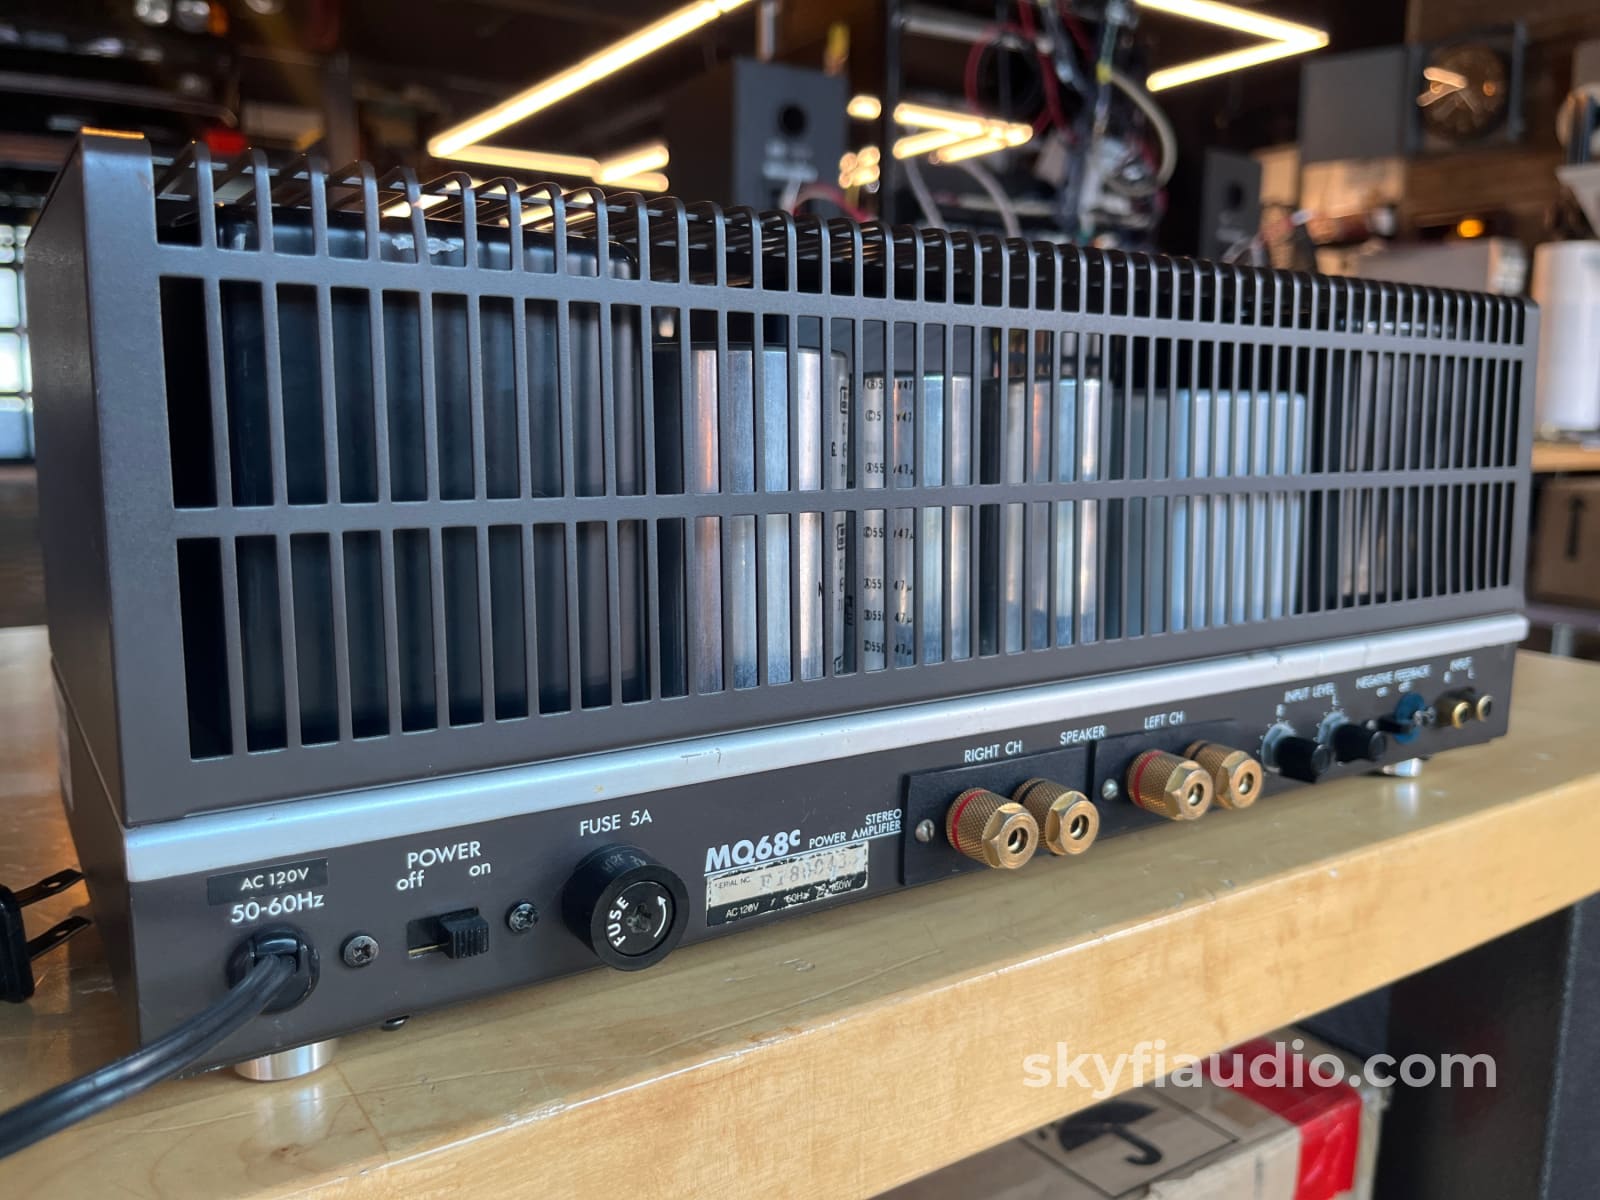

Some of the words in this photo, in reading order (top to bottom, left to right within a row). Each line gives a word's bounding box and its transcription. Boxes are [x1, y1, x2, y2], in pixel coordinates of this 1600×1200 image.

[1284, 686, 1311, 703] INPUT
[1312, 681, 1336, 698] LEVEL
[1144, 714, 1165, 730] LEFT
[1168, 711, 1184, 726] CH
[1060, 725, 1105, 745] SPEAKER
[964, 744, 1000, 763] RIGHT
[1004, 740, 1023, 755] CH
[579, 814, 621, 836] FUSE
[629, 808, 653, 827] 5A
[865, 808, 902, 825] STEREO
[809, 831, 846, 849] POWER
[852, 820, 901, 840] AMPLIFIER
[407, 840, 481, 869] POWER
[240, 875, 265, 891] AC
[269, 867, 309, 886] 120V
[396, 869, 425, 891] off
[469, 863, 491, 877] on
[231, 891, 325, 923] 50-60Hz
[608, 896, 630, 947] FUSE
